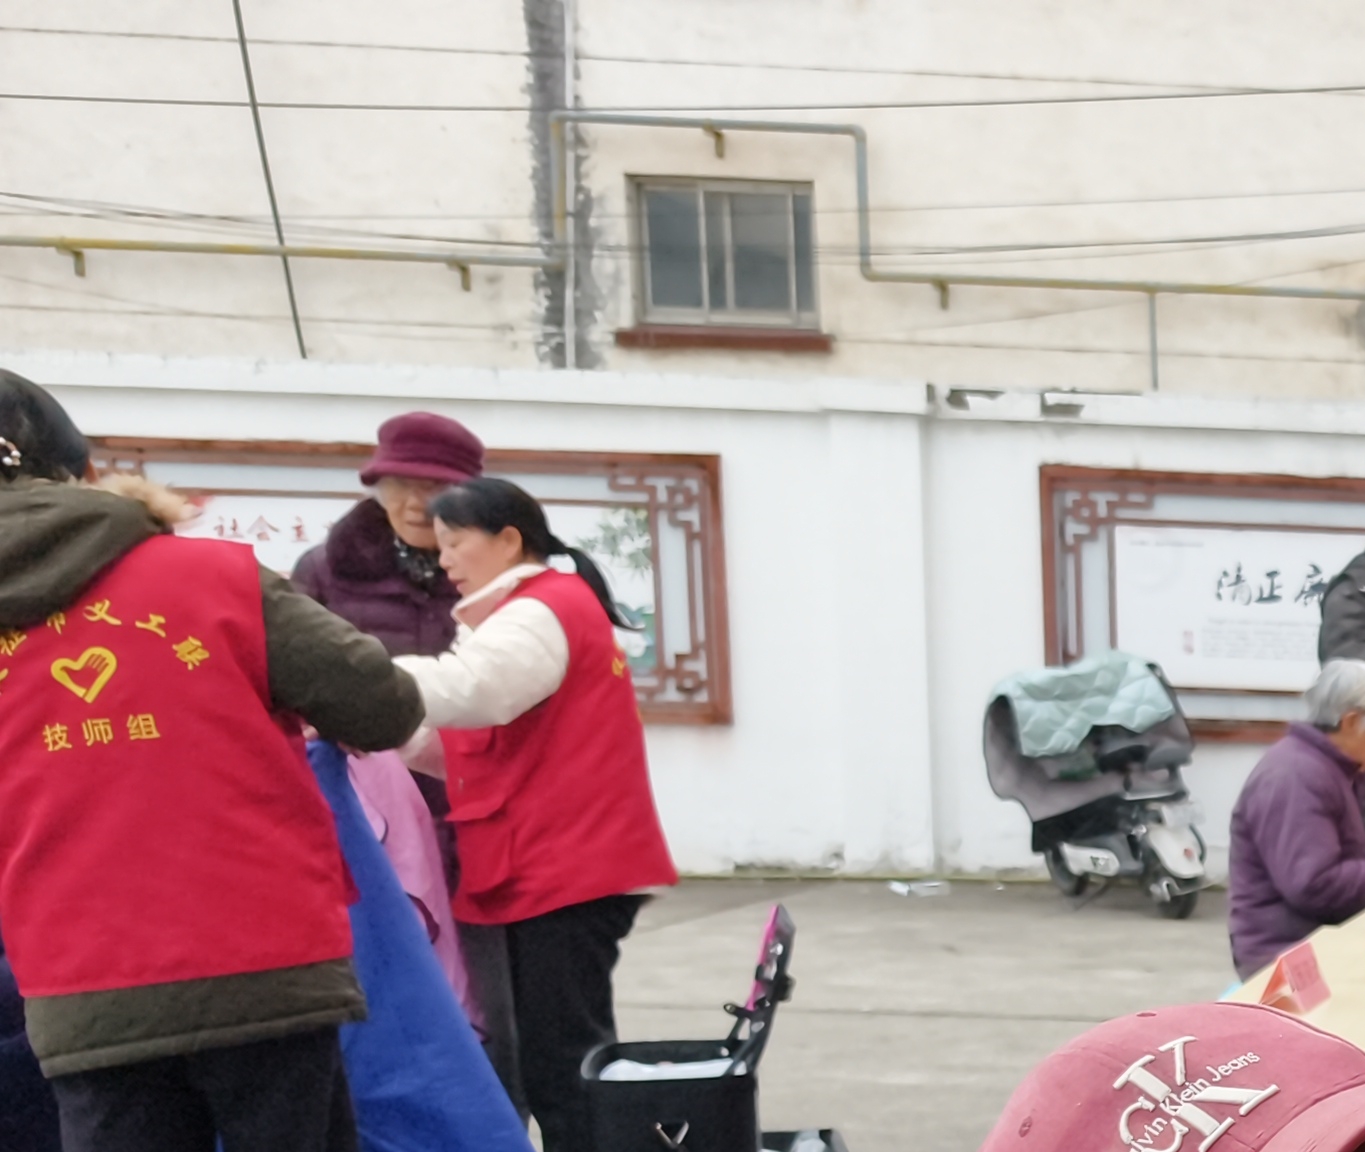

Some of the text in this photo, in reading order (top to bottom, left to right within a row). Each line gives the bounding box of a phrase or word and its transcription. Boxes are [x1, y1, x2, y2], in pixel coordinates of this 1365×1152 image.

[212, 514, 337, 543] 社会主
[42, 713, 161, 752] 技师组
[1159, 1077, 1211, 1117] Klein
[1205, 1050, 1261, 1083] Jeans
